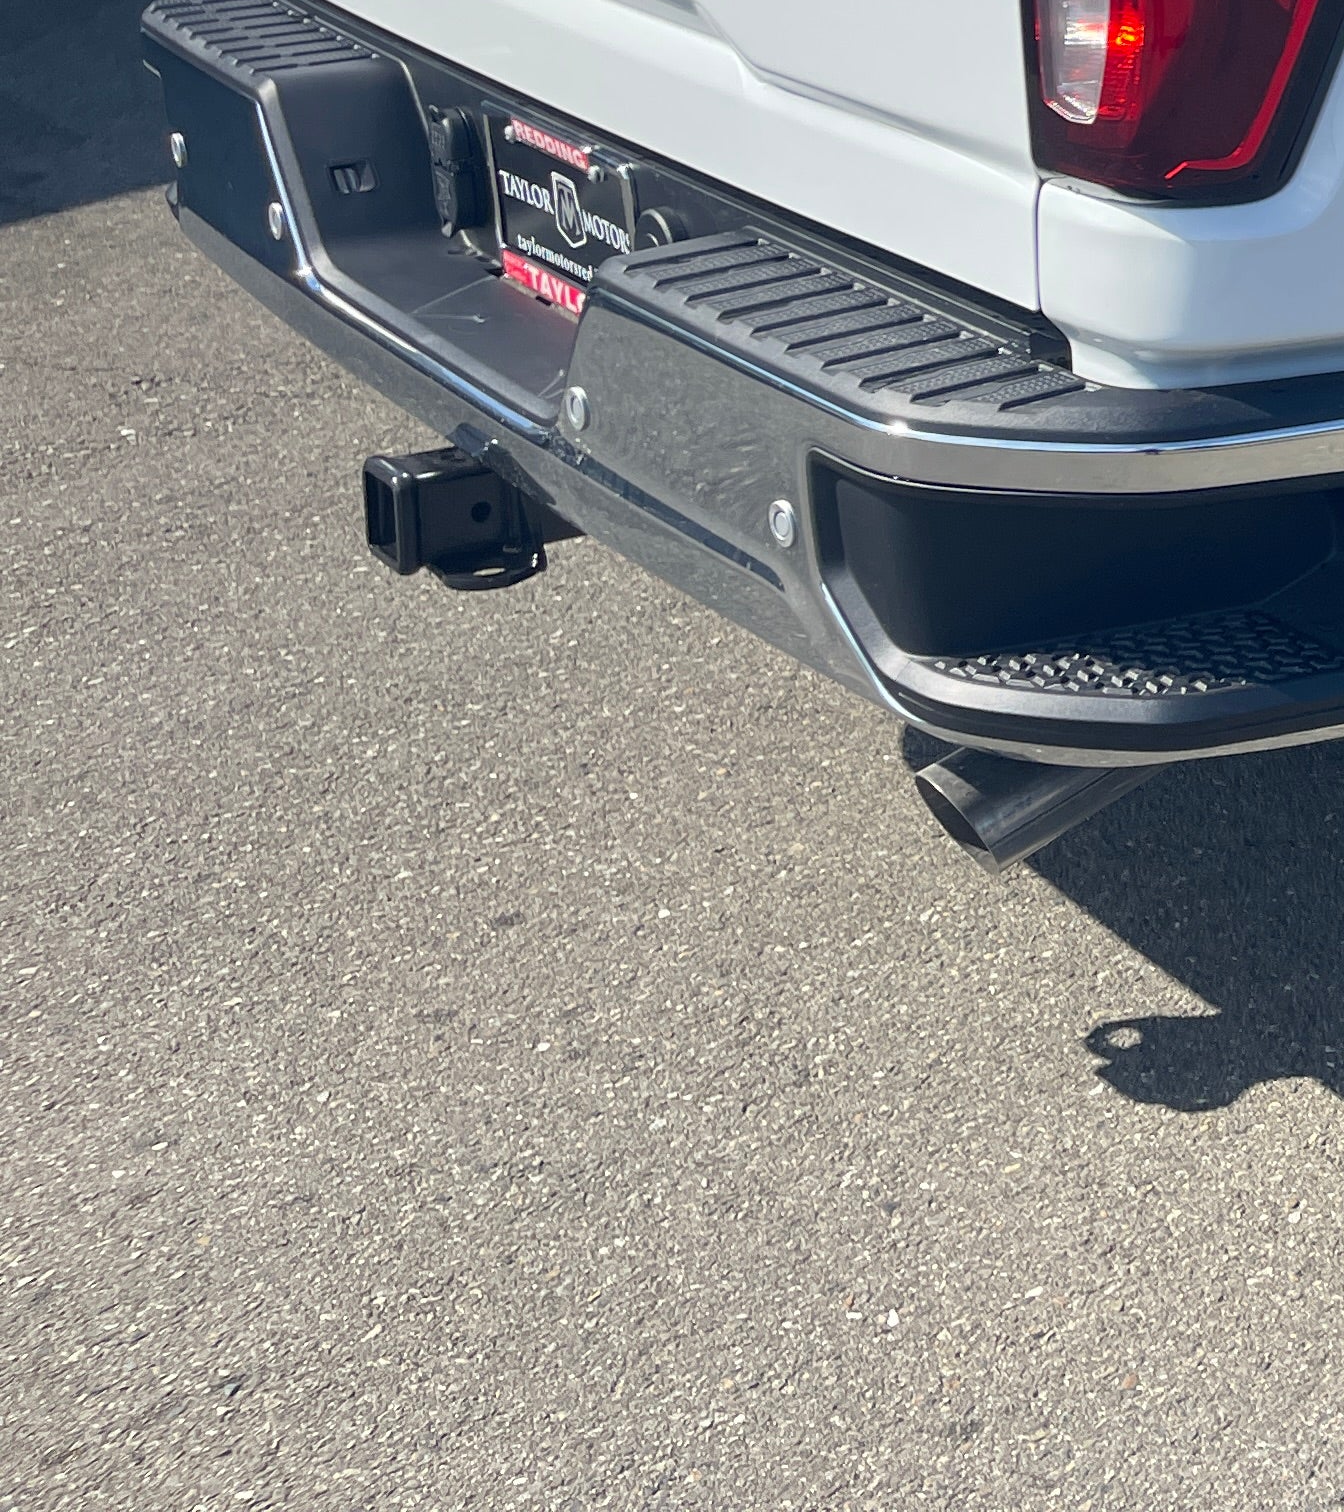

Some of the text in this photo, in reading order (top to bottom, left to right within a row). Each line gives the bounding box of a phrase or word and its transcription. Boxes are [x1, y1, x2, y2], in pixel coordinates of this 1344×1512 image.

[512, 120, 586, 169] REDDING
[498, 169, 555, 215] TAYLOR
[517, 234, 599, 281] taylormotorsred
